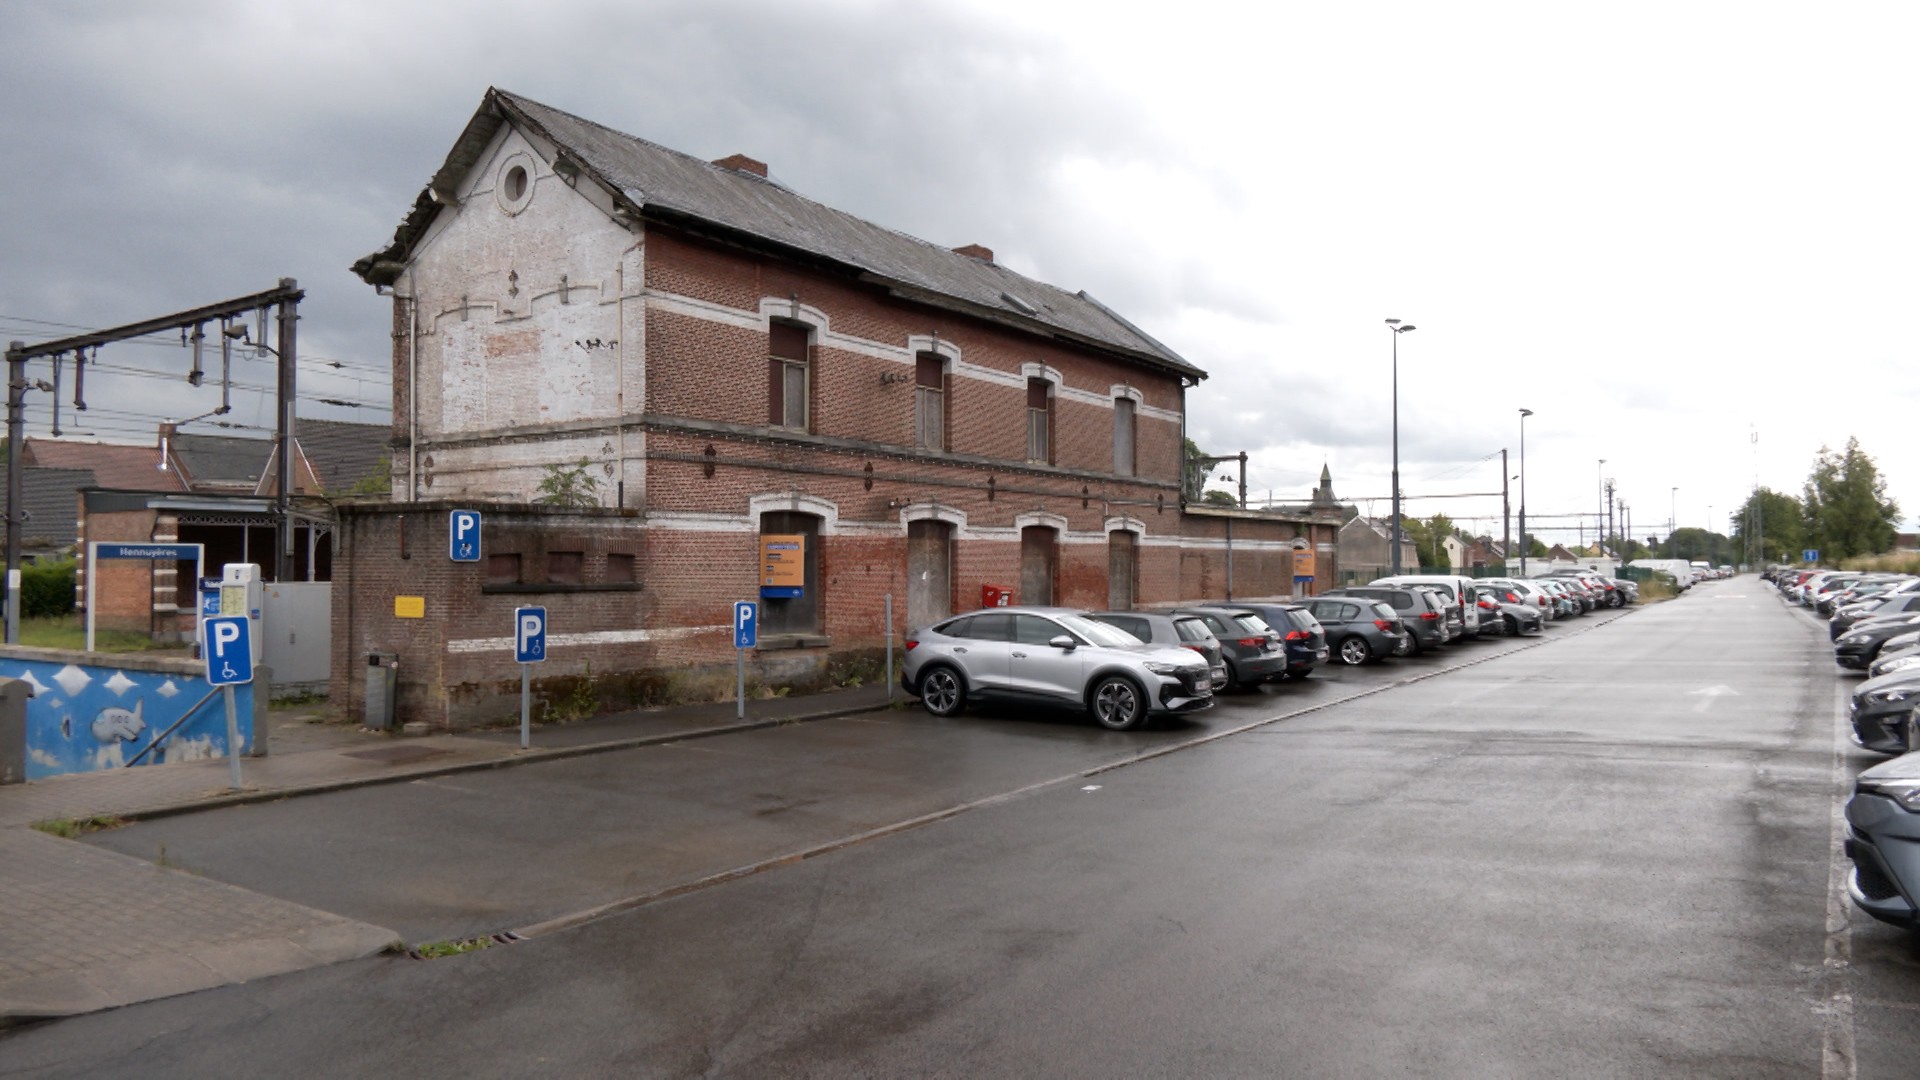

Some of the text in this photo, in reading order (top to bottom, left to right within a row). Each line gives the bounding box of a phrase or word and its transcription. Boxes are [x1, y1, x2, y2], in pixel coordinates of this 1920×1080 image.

[458, 514, 474, 540] P
[740, 605, 752, 630] P
[214, 622, 239, 657] P
[521, 615, 542, 653] P
